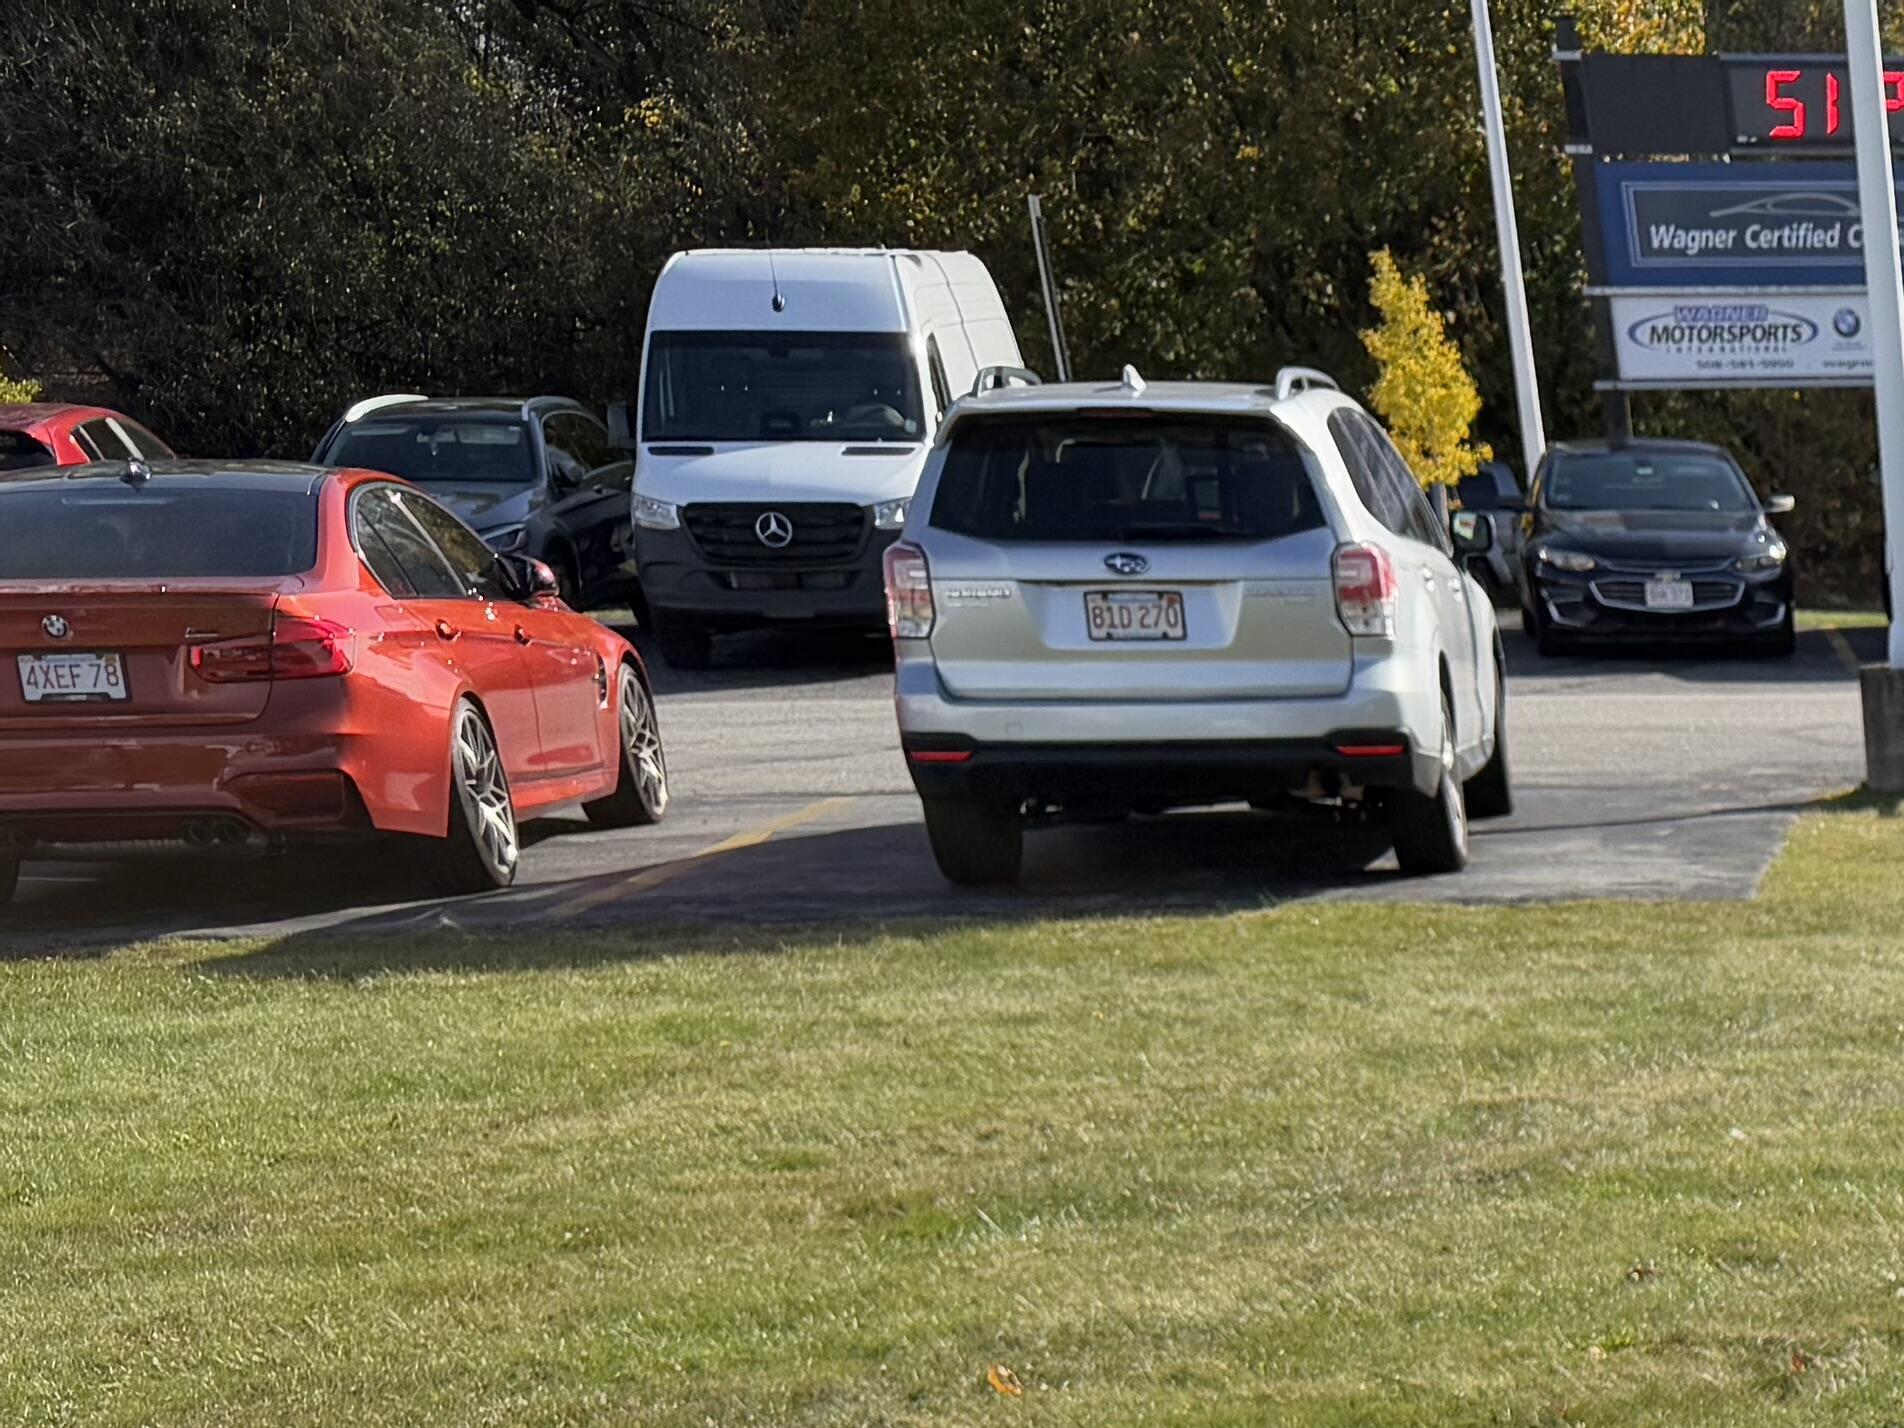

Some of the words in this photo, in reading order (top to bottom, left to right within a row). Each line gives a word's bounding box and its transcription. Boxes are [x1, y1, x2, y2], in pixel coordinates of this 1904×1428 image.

[1650, 224, 1736, 255] Wagner
[1744, 221, 1840, 250] Certified
[1673, 304, 1770, 323] WAGNER
[1649, 323, 1802, 345] MOTORSPORTS
[1092, 604, 1130, 630] 81D
[1139, 603, 1179, 629] 270
[26, 664, 81, 690] 4XEF
[88, 663, 120, 688] 78
